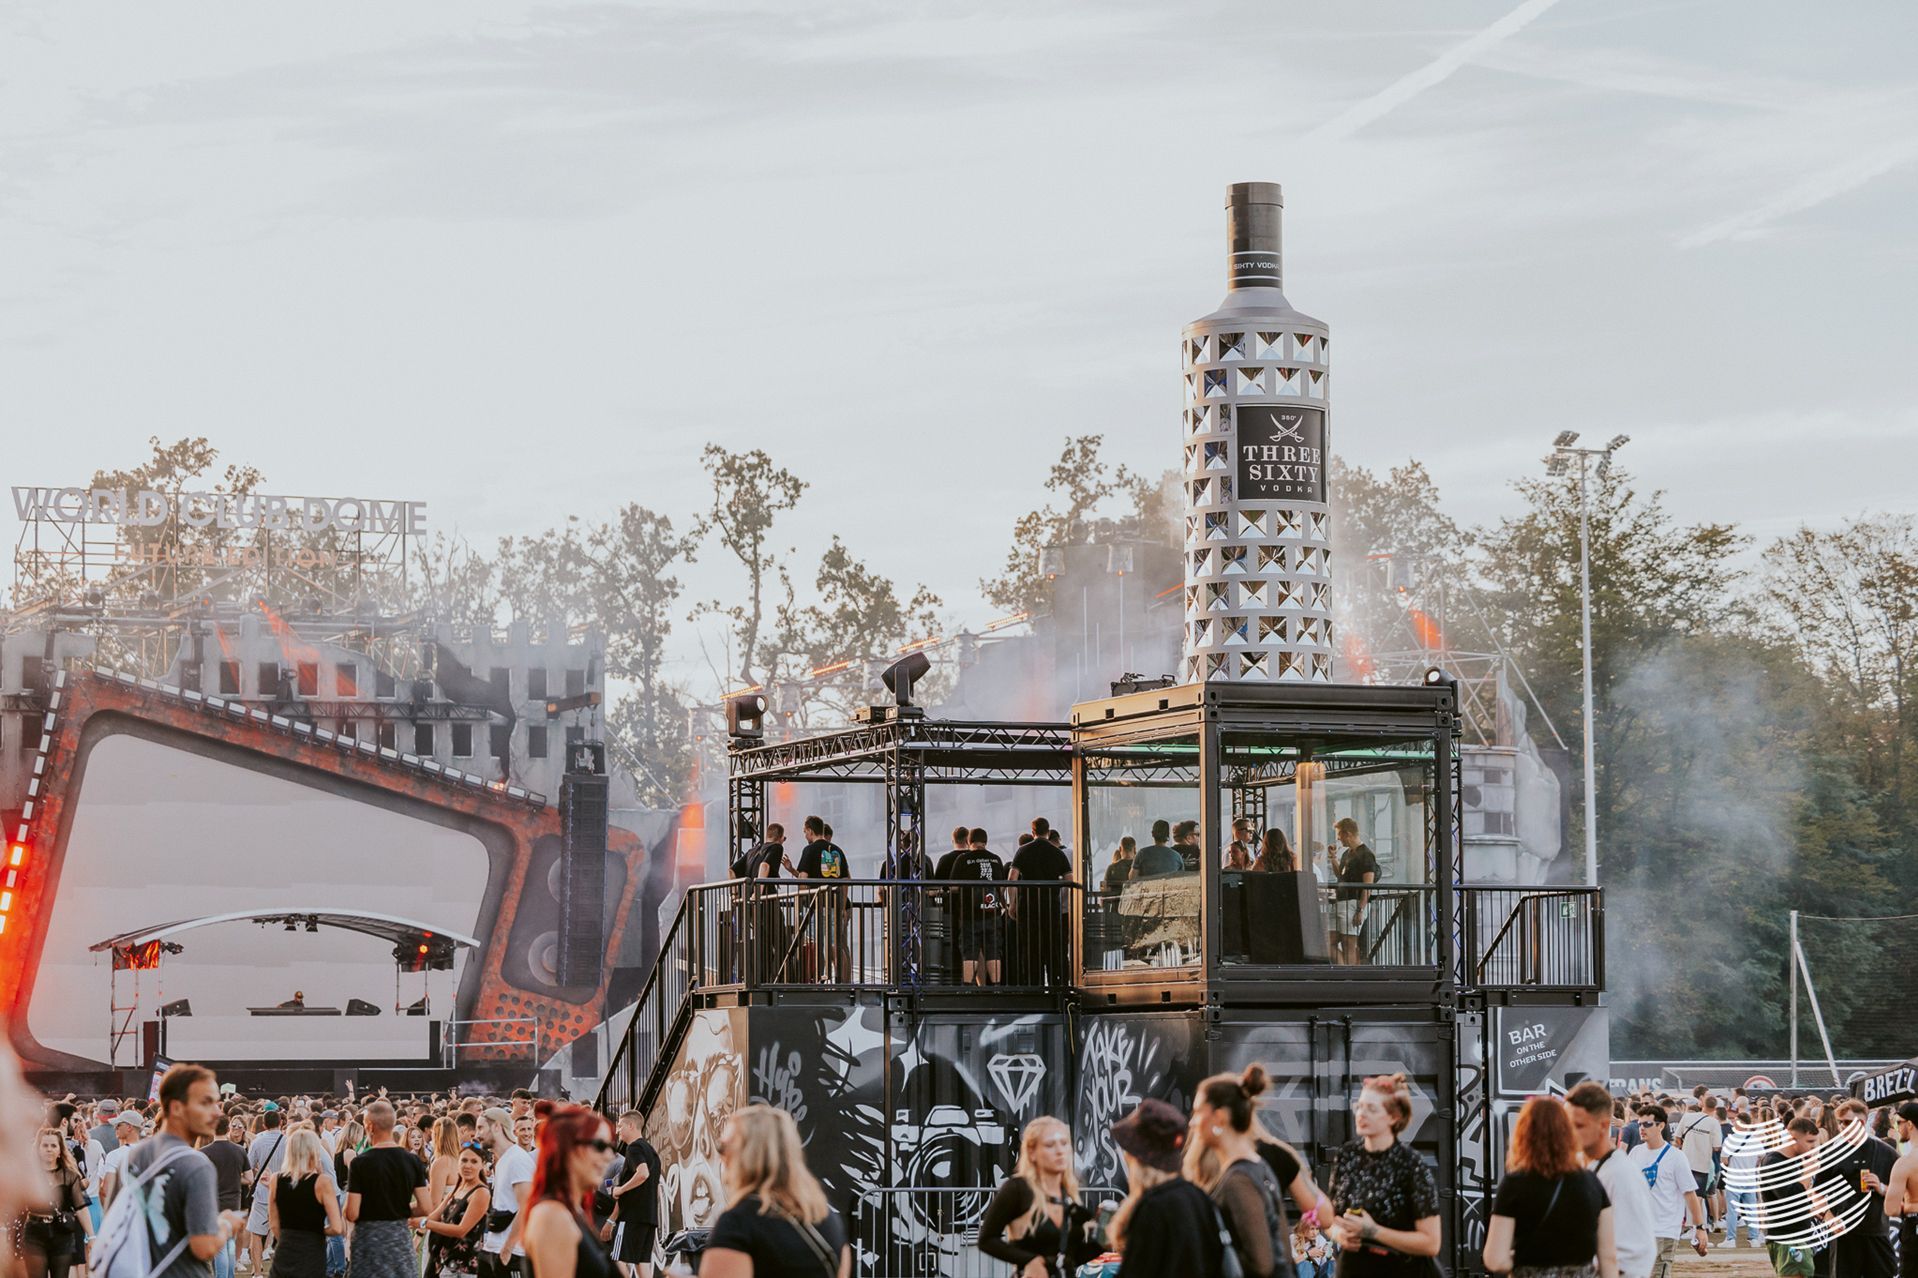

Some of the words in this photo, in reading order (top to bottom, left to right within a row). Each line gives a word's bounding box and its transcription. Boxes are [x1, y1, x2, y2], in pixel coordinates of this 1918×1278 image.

[1243, 445, 1321, 464] THREE
[1249, 464, 1319, 483] SIXTY
[1260, 484, 1313, 494] VODKA
[11, 486, 169, 527] WORLD
[181, 490, 290, 531] CLUB
[302, 497, 428, 536] DOME
[1508, 1023, 1547, 1045] BAR
[1516, 1045, 1529, 1055] ON
[1529, 1041, 1546, 1051] THE
[1510, 1055, 1537, 1068] OTHER
[1537, 1049, 1558, 1060] SIDE
